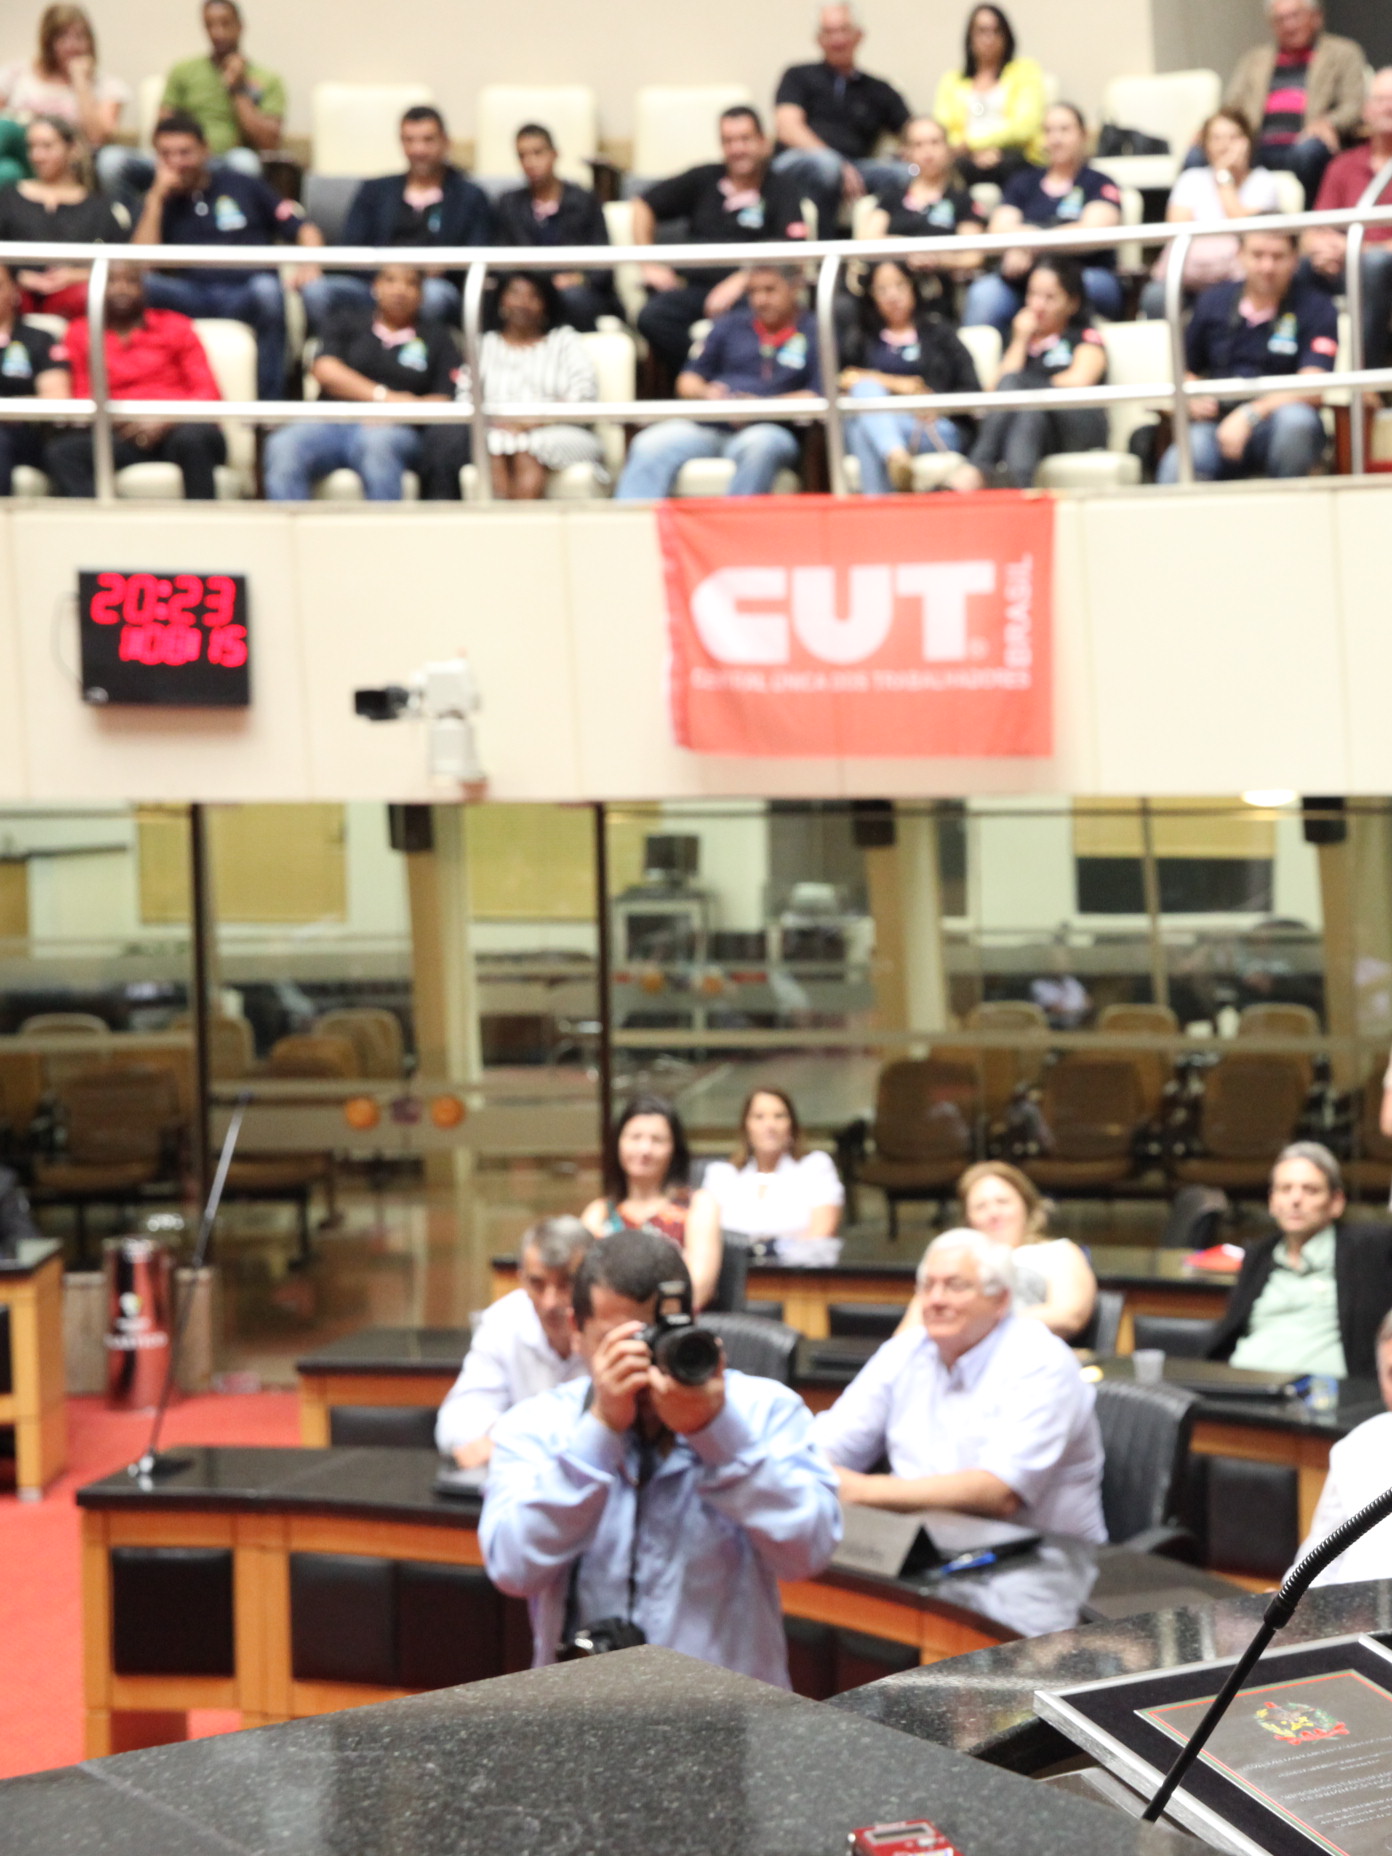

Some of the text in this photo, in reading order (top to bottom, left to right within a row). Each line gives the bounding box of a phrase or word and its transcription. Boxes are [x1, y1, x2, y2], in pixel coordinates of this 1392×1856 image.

[90, 572, 237, 627] 20:23
[691, 560, 995, 665] CUT
[1004, 553, 1033, 669] BRASIL
